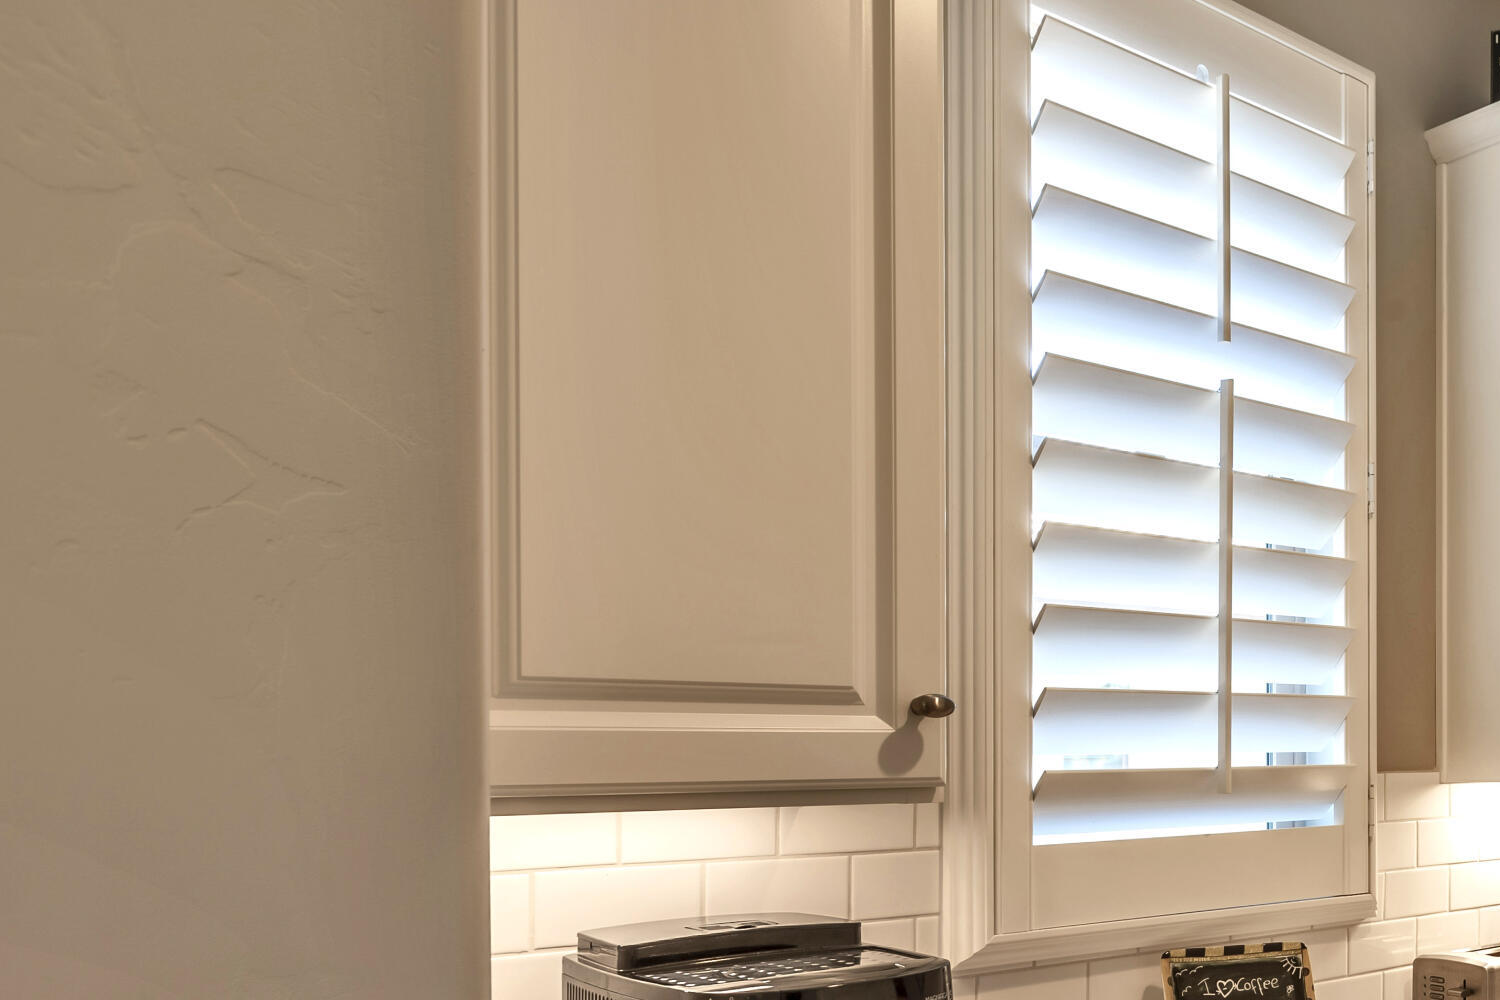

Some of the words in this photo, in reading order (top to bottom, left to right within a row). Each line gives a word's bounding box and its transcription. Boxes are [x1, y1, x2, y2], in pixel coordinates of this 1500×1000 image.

[1495, 34, 1499, 44] I
[1198, 977, 1215, 996] I
[1236, 977, 1280, 997] Coffee
